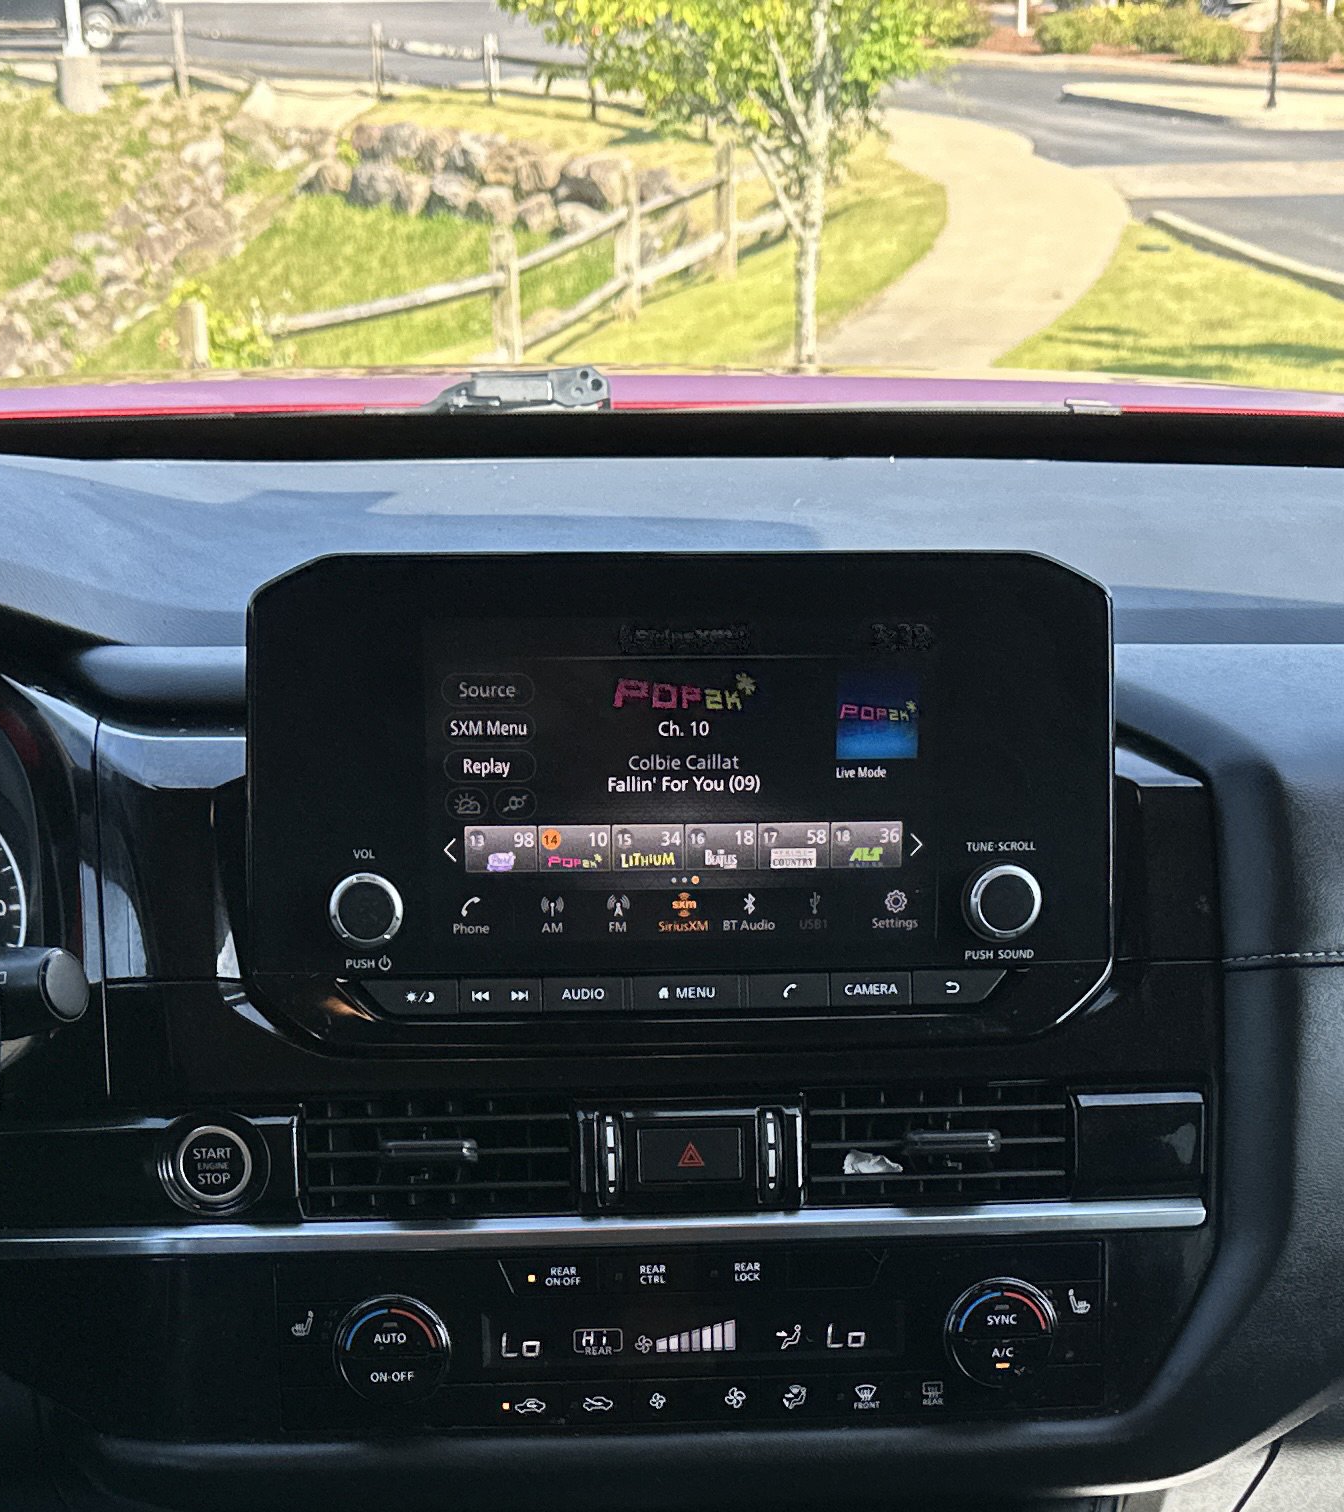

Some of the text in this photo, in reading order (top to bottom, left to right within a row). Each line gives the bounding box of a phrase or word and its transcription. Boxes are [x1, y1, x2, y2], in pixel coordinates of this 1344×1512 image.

[459, 681, 516, 698] Source
[450, 720, 527, 736] SXM Menu
[658, 720, 709, 737] Ch. 10
[463, 758, 510, 777] Replay
[628, 754, 739, 771] Colbie Caillat
[836, 766, 887, 779] Live Mode
[608, 774, 761, 794] Fallin' For You (09)
[469, 832, 535, 848] 13 98
[543, 832, 608, 848] 14 10
[617, 831, 681, 847] 15 34
[690, 830, 754, 846] 16 18
[762, 829, 827, 845] 17 58
[835, 828, 900, 844] 18 36
[353, 849, 375, 859] VOL
[453, 924, 490, 934] Phone
[541, 922, 563, 933] AM
[608, 922, 627, 932] FM
[658, 920, 709, 932] SiriusXM
[722, 920, 776, 931] BT Audio
[872, 918, 919, 930] Settings
[964, 949, 1034, 960] PUSH SOUND
[345, 959, 375, 969] PUSH
[561, 988, 605, 1000] AUDIO
[676, 987, 716, 999] MENU
[844, 983, 898, 996] CAMERA
[193, 1148, 232, 1160] START
[197, 1173, 231, 1185] STOP
[550, 1266, 577, 1276] REAR
[639, 1264, 666, 1275] REAR
[734, 1262, 760, 1272] REAR
[640, 1275, 665, 1284] CTRL
[734, 1272, 760, 1282] LOCK
[987, 1314, 1018, 1326] SYNC
[373, 1332, 406, 1345] AUTO
[585, 1346, 613, 1355] REAR
[991, 1347, 1014, 1359] A/C
[854, 1400, 880, 1409] FRONT
